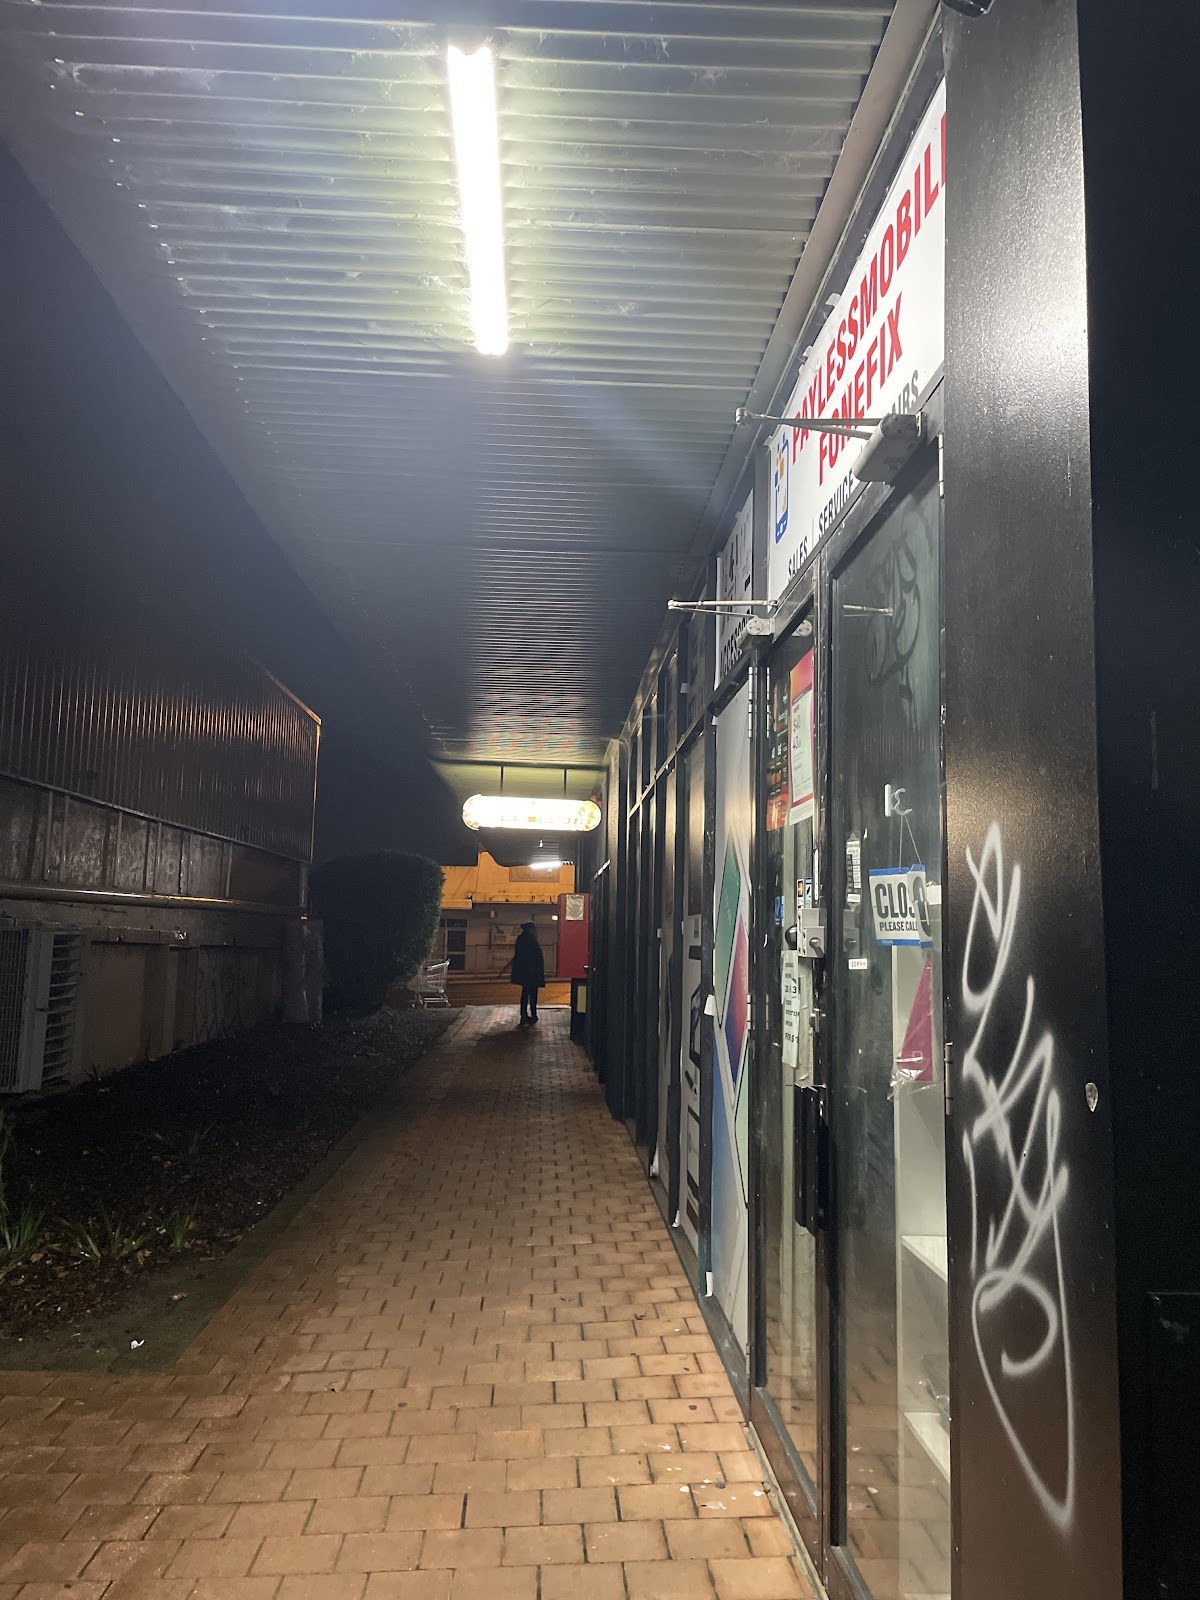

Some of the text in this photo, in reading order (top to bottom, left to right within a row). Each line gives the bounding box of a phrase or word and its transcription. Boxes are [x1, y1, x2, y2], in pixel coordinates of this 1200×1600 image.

[819, 290, 903, 487] FONEFIX
[788, 535, 808, 581] SALES
[879, 921, 905, 931] PLEASE
